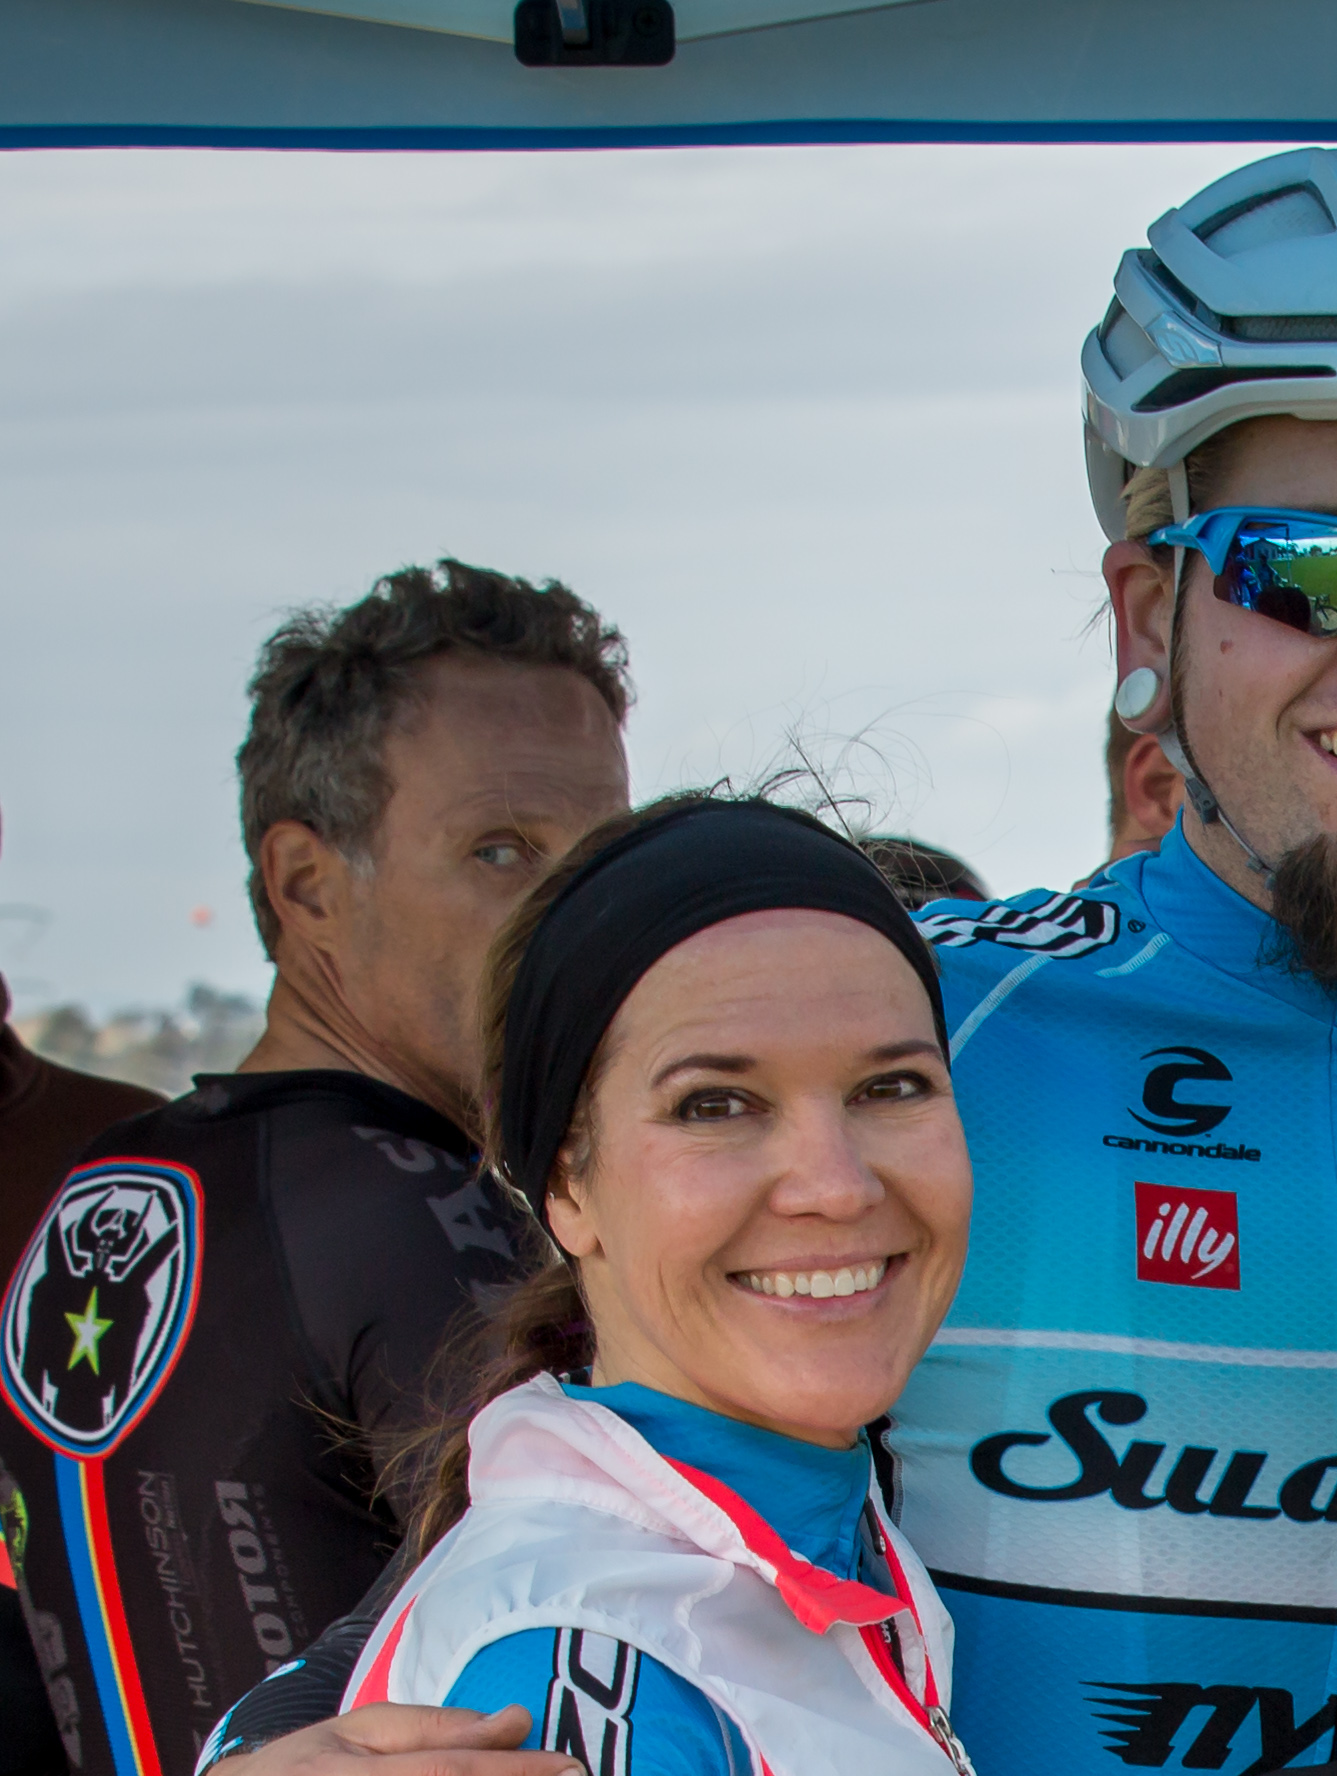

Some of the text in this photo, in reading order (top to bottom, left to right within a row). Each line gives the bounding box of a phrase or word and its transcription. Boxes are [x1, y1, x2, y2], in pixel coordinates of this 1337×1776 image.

[1102, 1133, 1262, 1163] cannondale
[1143, 1201, 1236, 1280] illy
[137, 1470, 212, 1708] HUTCHINSON
[214, 1480, 294, 1675] OTOR
